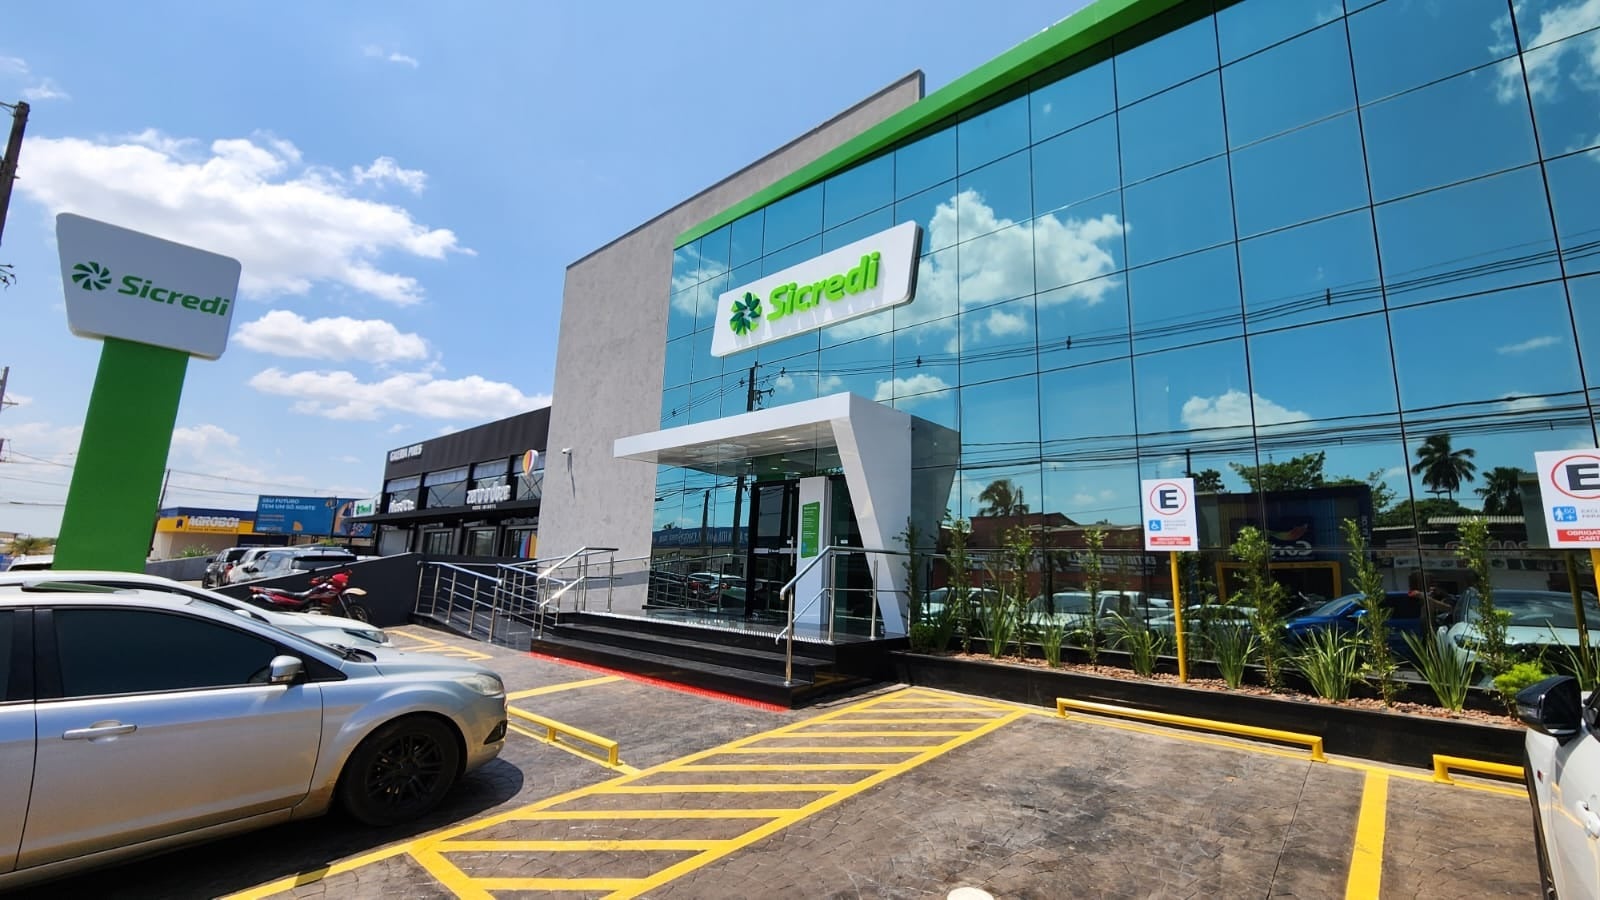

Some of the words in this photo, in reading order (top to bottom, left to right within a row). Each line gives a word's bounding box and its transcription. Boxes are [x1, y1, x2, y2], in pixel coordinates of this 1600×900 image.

[118, 275, 230, 316] Sicredi
[767, 251, 881, 321] Sicredi
[1565, 463, 1600, 490] E
[1160, 489, 1179, 508] E
[189, 516, 240, 527] AGROBOI
